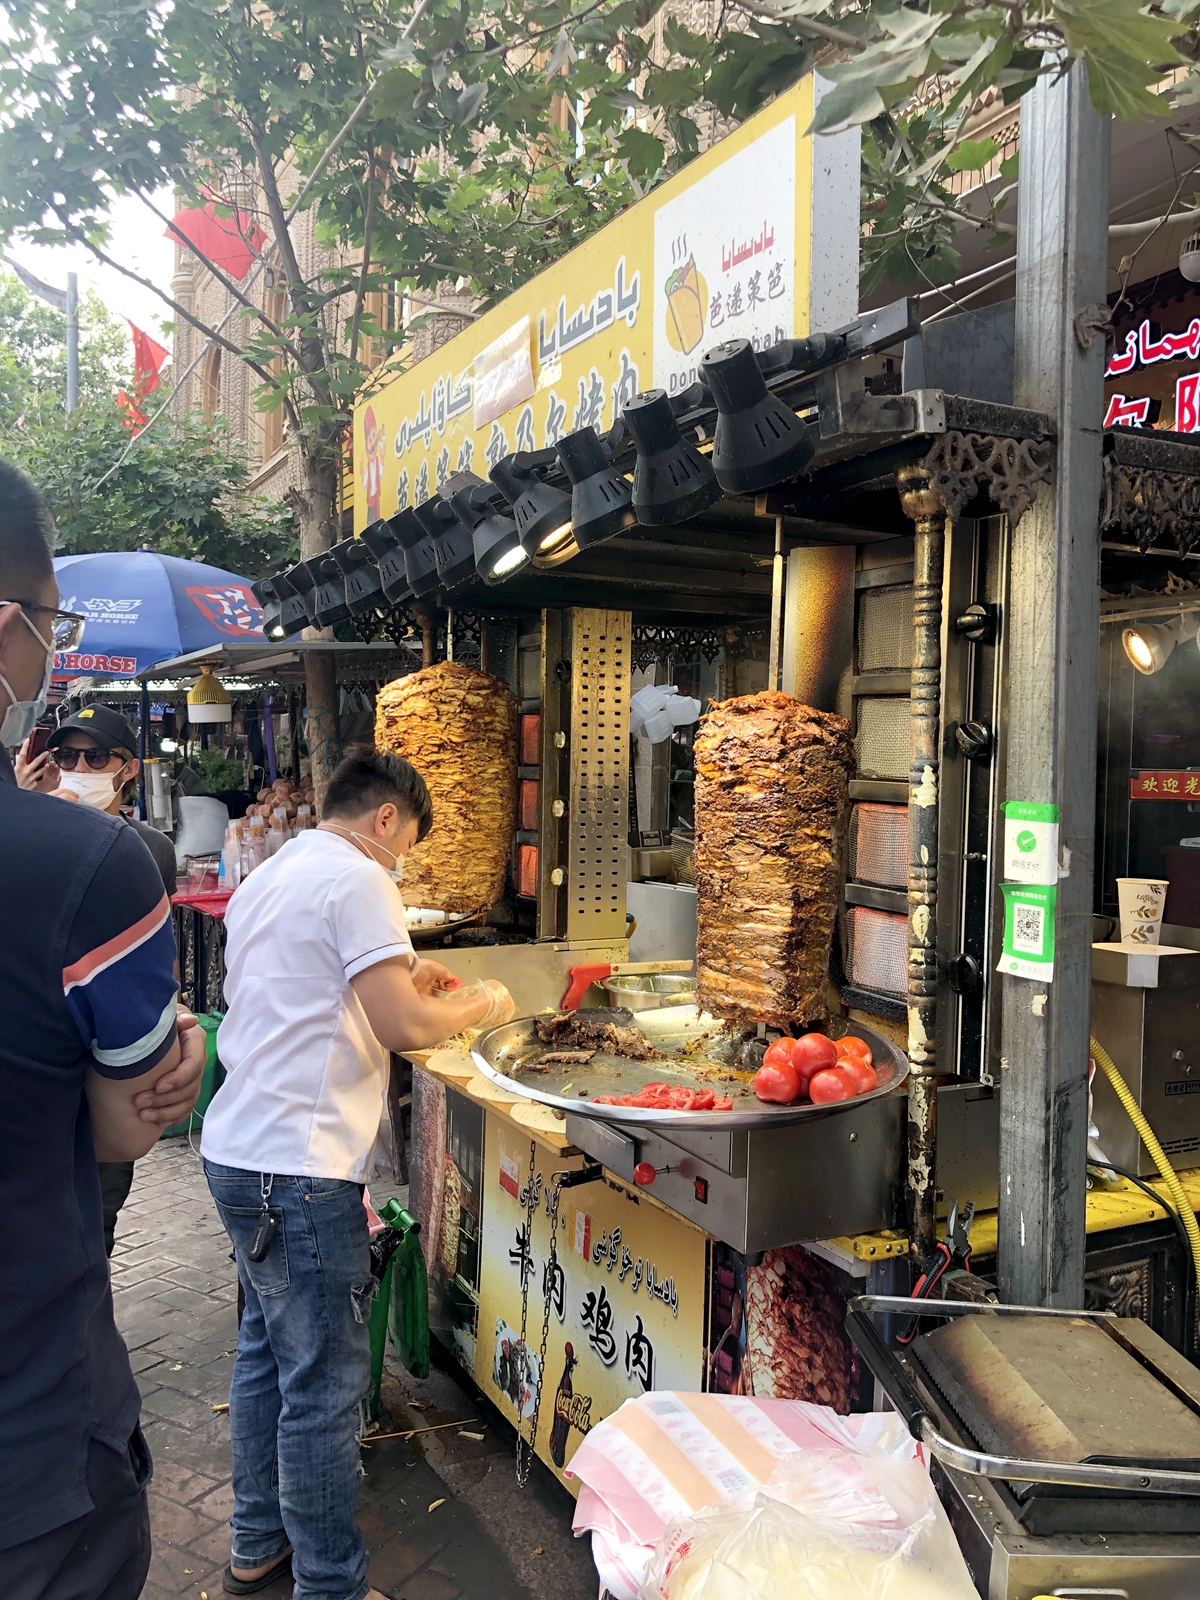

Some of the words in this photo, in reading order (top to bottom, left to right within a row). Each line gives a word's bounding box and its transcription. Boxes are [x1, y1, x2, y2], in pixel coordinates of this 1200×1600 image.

[100, 612, 139, 620] HORSE
[64, 653, 137, 674] HORSE
[1011, 858, 1040, 872] 微信支付
